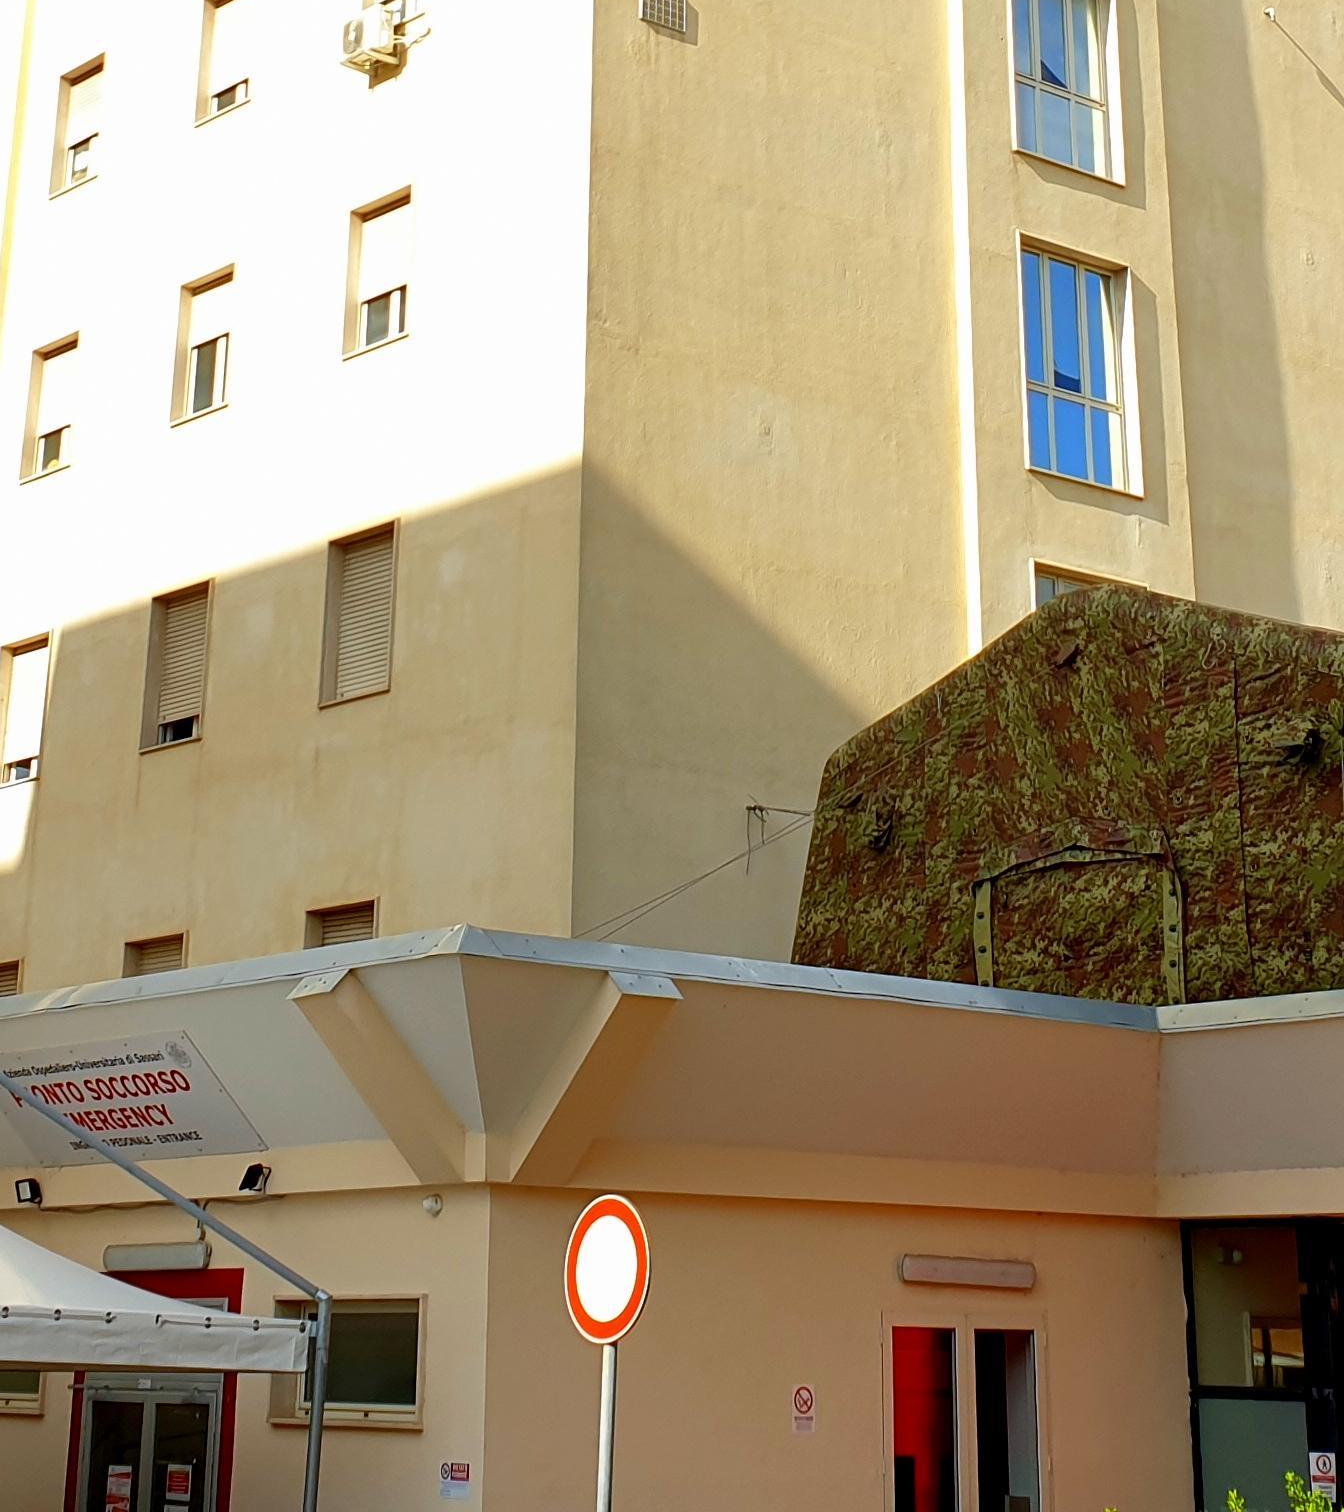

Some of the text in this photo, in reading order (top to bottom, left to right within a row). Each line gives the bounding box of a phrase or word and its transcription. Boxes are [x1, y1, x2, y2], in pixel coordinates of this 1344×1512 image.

[134, 1050, 165, 1063] Sassari
[84, 1070, 191, 1101] SOCCORSO
[63, 1104, 174, 1132] MERGENCY
[157, 1131, 203, 1144] ENTRANCE
